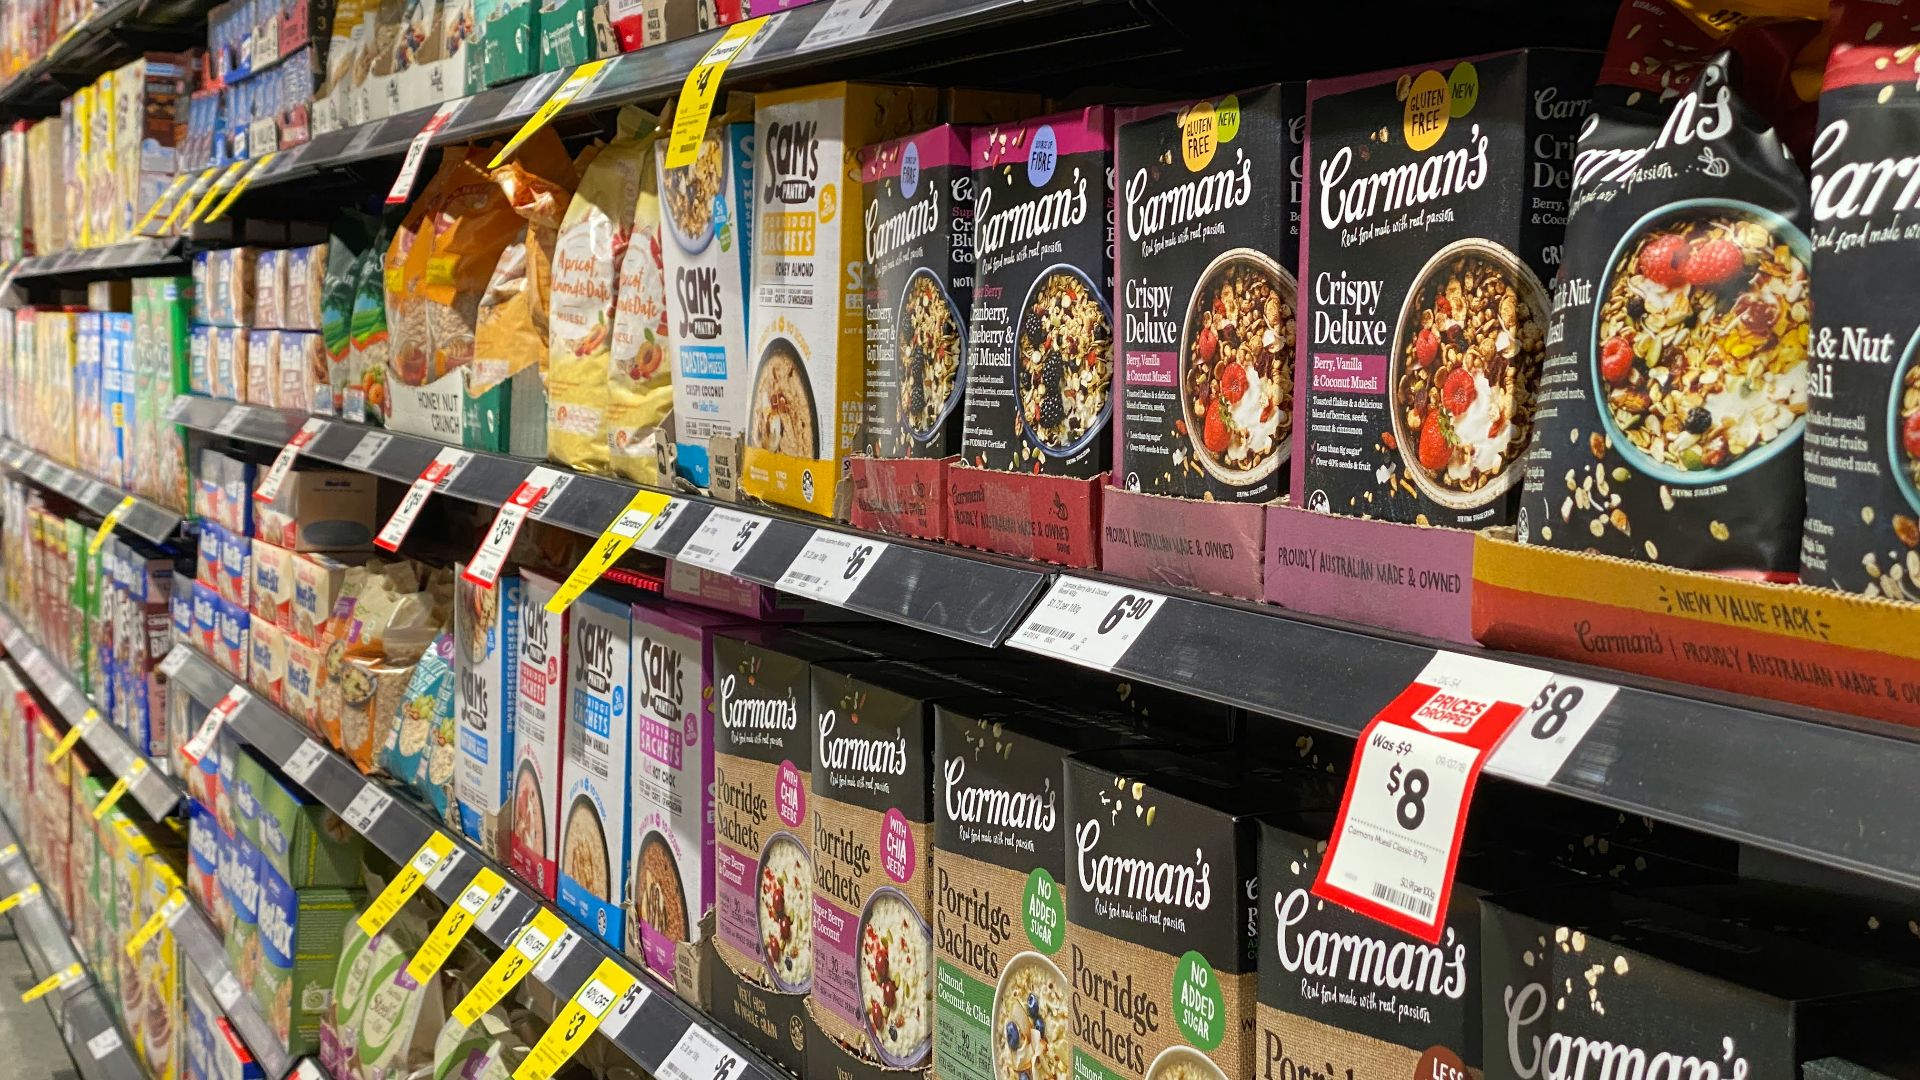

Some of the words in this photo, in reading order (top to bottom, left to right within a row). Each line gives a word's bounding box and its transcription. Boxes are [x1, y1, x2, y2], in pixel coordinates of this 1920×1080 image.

[1411, 88, 1444, 112] GLUTEN
[1452, 83, 1474, 100] NEW
[1186, 117, 1212, 137] GLUTEN
[1218, 112, 1237, 126] NEW
[1411, 109, 1440, 137] FREE
[1032, 152, 1053, 172] FIBRE
[1188, 135, 1210, 159] FREE
[1319, 123, 1489, 230] Carman's
[1125, 147, 1251, 242] Carman's
[1532, 197, 1565, 211] Berry,
[865, 180, 938, 265] Carman's
[972, 167, 1088, 260] Carman's
[1340, 228, 1357, 248] Real
[1359, 225, 1373, 247] food
[1374, 220, 1390, 236] made
[1393, 214, 1408, 232] with
[1409, 210, 1424, 229] real
[1425, 207, 1454, 232] passion
[1531, 214, 1542, 225] &
[1834, 220, 1871, 254] food
[1869, 214, 1900, 242] made
[558, 249, 599, 277] Apricot,
[1126, 278, 1173, 318] Crispy
[1315, 270, 1383, 316] Crispy
[1568, 278, 1592, 307] Nut
[1006, 326, 1014, 343] &
[1126, 313, 1177, 344] Deluxe
[1314, 310, 1387, 346] Deluxe
[980, 347, 1012, 367] Muesli
[1126, 353, 1141, 367] Berry,
[1141, 353, 1160, 366] Vanilla
[1817, 328, 1836, 358] &
[1838, 327, 1895, 364] Nut
[1131, 370, 1151, 382] Coconut
[1152, 370, 1171, 383] Muesli
[1313, 356, 1335, 371] Berry,
[1336, 357, 1362, 372] Vanilla
[1320, 376, 1350, 389] Coconut
[1351, 376, 1378, 390] Muesli
[418, 394, 440, 410] HONEY
[443, 395, 458, 412] NUT
[1358, 399, 1383, 409] delicious
[431, 416, 460, 434] CRUNCH
[1832, 415, 1866, 431] muesli
[1840, 434, 1868, 451] fruits
[1820, 452, 1854, 471] roasted
[1855, 460, 1880, 476] nuts,
[732, 520, 760, 552] $5
[1044, 524, 1070, 541] OWNED
[1105, 526, 1131, 547] PROUDLY
[1132, 531, 1172, 551] AUSTRALIAN
[1172, 535, 1194, 556] MADE
[1196, 541, 1203, 556] &
[1205, 542, 1234, 560] OWNED
[602, 537, 622, 566] $4
[843, 544, 874, 580] $6
[1278, 547, 1316, 573] PROUDLY
[1319, 554, 1374, 581] AUSTRALIAN
[1376, 563, 1404, 586] MADE
[1408, 570, 1416, 587] &
[1419, 572, 1461, 594] OWNED
[1674, 588, 1713, 616] NEW
[1715, 594, 1766, 625] VALUE
[1772, 602, 1819, 638] PACK
[1574, 619, 1664, 655] Carman's
[1682, 645, 1740, 673] PROUDLY
[1747, 652, 1834, 688] AUSTRALIAN
[1836, 669, 1879, 697] MADE
[1885, 677, 1899, 702] &
[720, 673, 797, 730] Carman's
[1417, 705, 1474, 729] DROPPED
[1429, 693, 1487, 717] PRICES
[1531, 681, 1584, 740] $8
[640, 731, 680, 767] SACHETS
[818, 709, 907, 776] Carman's
[1372, 733, 1394, 752] Was
[1395, 740, 1413, 757] $9
[783, 766, 797, 783] WITH
[717, 767, 767, 826] Porridge
[780, 782, 798, 810] CHIA
[944, 755, 1056, 832] Carman's
[1386, 762, 1430, 831] $8
[717, 802, 760, 853] Sachets
[781, 804, 797, 824] SEEDS
[890, 816, 907, 838] WITH
[813, 810, 871, 878] Porridge
[886, 834, 907, 866] CHIA
[1347, 825, 1374, 843] Carmans
[1375, 834, 1392, 850] Muesli
[1392, 840, 1413, 857] Classic
[813, 849, 861, 908] Sachets
[886, 855, 905, 879] SEEDS
[1075, 818, 1211, 911] Carman's
[1037, 875, 1051, 899] NO
[813, 898, 827, 918] Super
[827, 907, 845, 930] Berry
[937, 866, 1011, 945] Porridge
[1029, 894, 1057, 928] ADDED
[818, 917, 841, 943] Coconut
[936, 909, 999, 979] Sachets
[1029, 919, 1053, 947] SUGAR
[1274, 888, 1467, 999] Carman's
[502, 955, 524, 982] $3
[938, 966, 965, 997] Almond,
[1191, 959, 1208, 988] NO
[1071, 943, 1159, 1036] Porridge
[1181, 983, 1215, 1021] ADDED
[1301, 978, 1319, 999] Real
[1321, 984, 1337, 1004] food
[1339, 989, 1357, 1006] made
[1359, 992, 1376, 1010] with
[1379, 996, 1396, 1014] real
[1398, 1003, 1431, 1024] passion
[937, 983, 965, 1013] Coconut
[965, 1001, 972, 1017] &
[972, 1004, 991, 1028] Chia
[565, 1010, 586, 1041] $3
[1072, 992, 1145, 1075] Sachets
[1182, 1008, 1210, 1041] SUGAR
[1504, 982, 1748, 1080] Carman's
